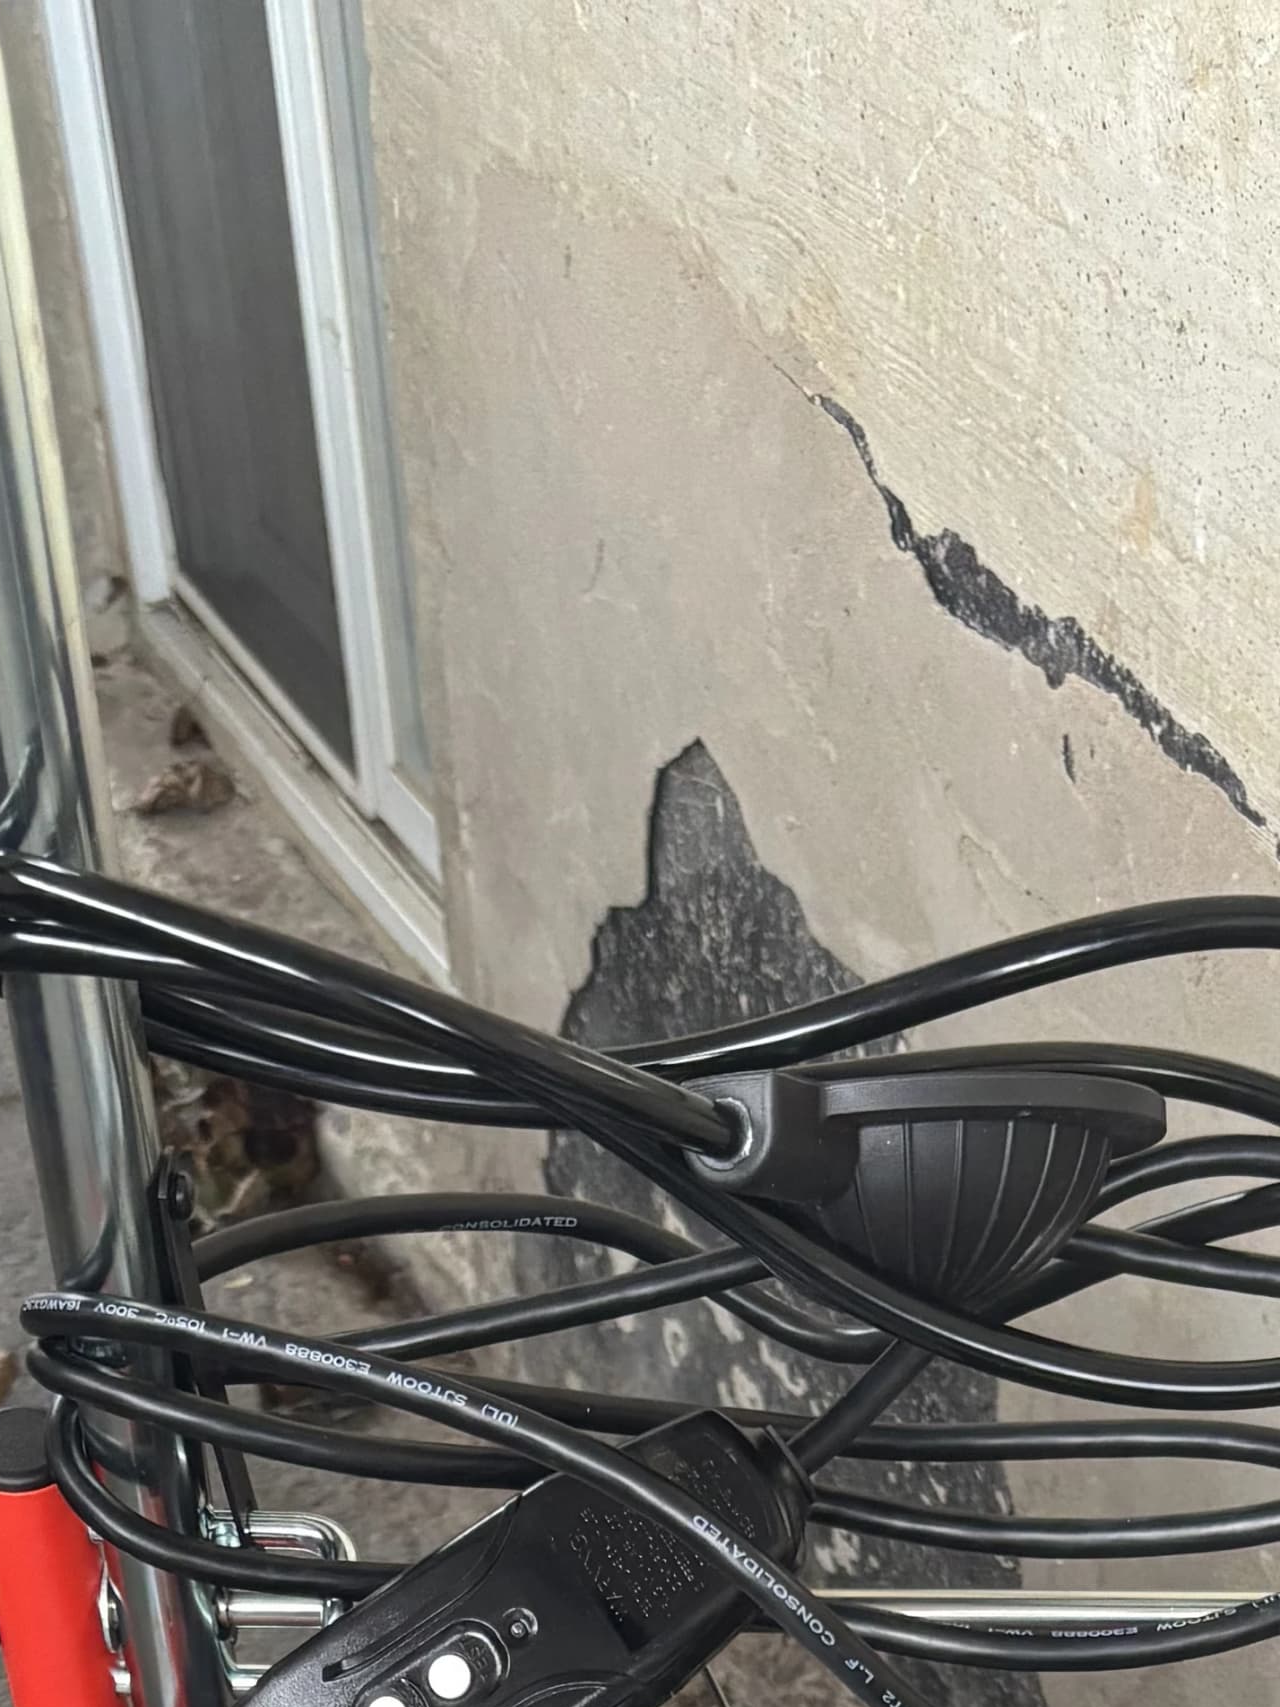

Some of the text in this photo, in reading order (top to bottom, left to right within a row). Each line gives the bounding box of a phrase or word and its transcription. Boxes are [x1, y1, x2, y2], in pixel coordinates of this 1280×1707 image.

[93, 1300, 140, 1318] 300V
[222, 1326, 267, 1348] VW-1
[285, 1342, 371, 1376] E300888
[386, 1370, 468, 1407] SJTOOW
[480, 1402, 519, 1428] (UL)
[690, 1514, 836, 1647] CONSOLIDATED
[842, 1656, 874, 1685] L.F
